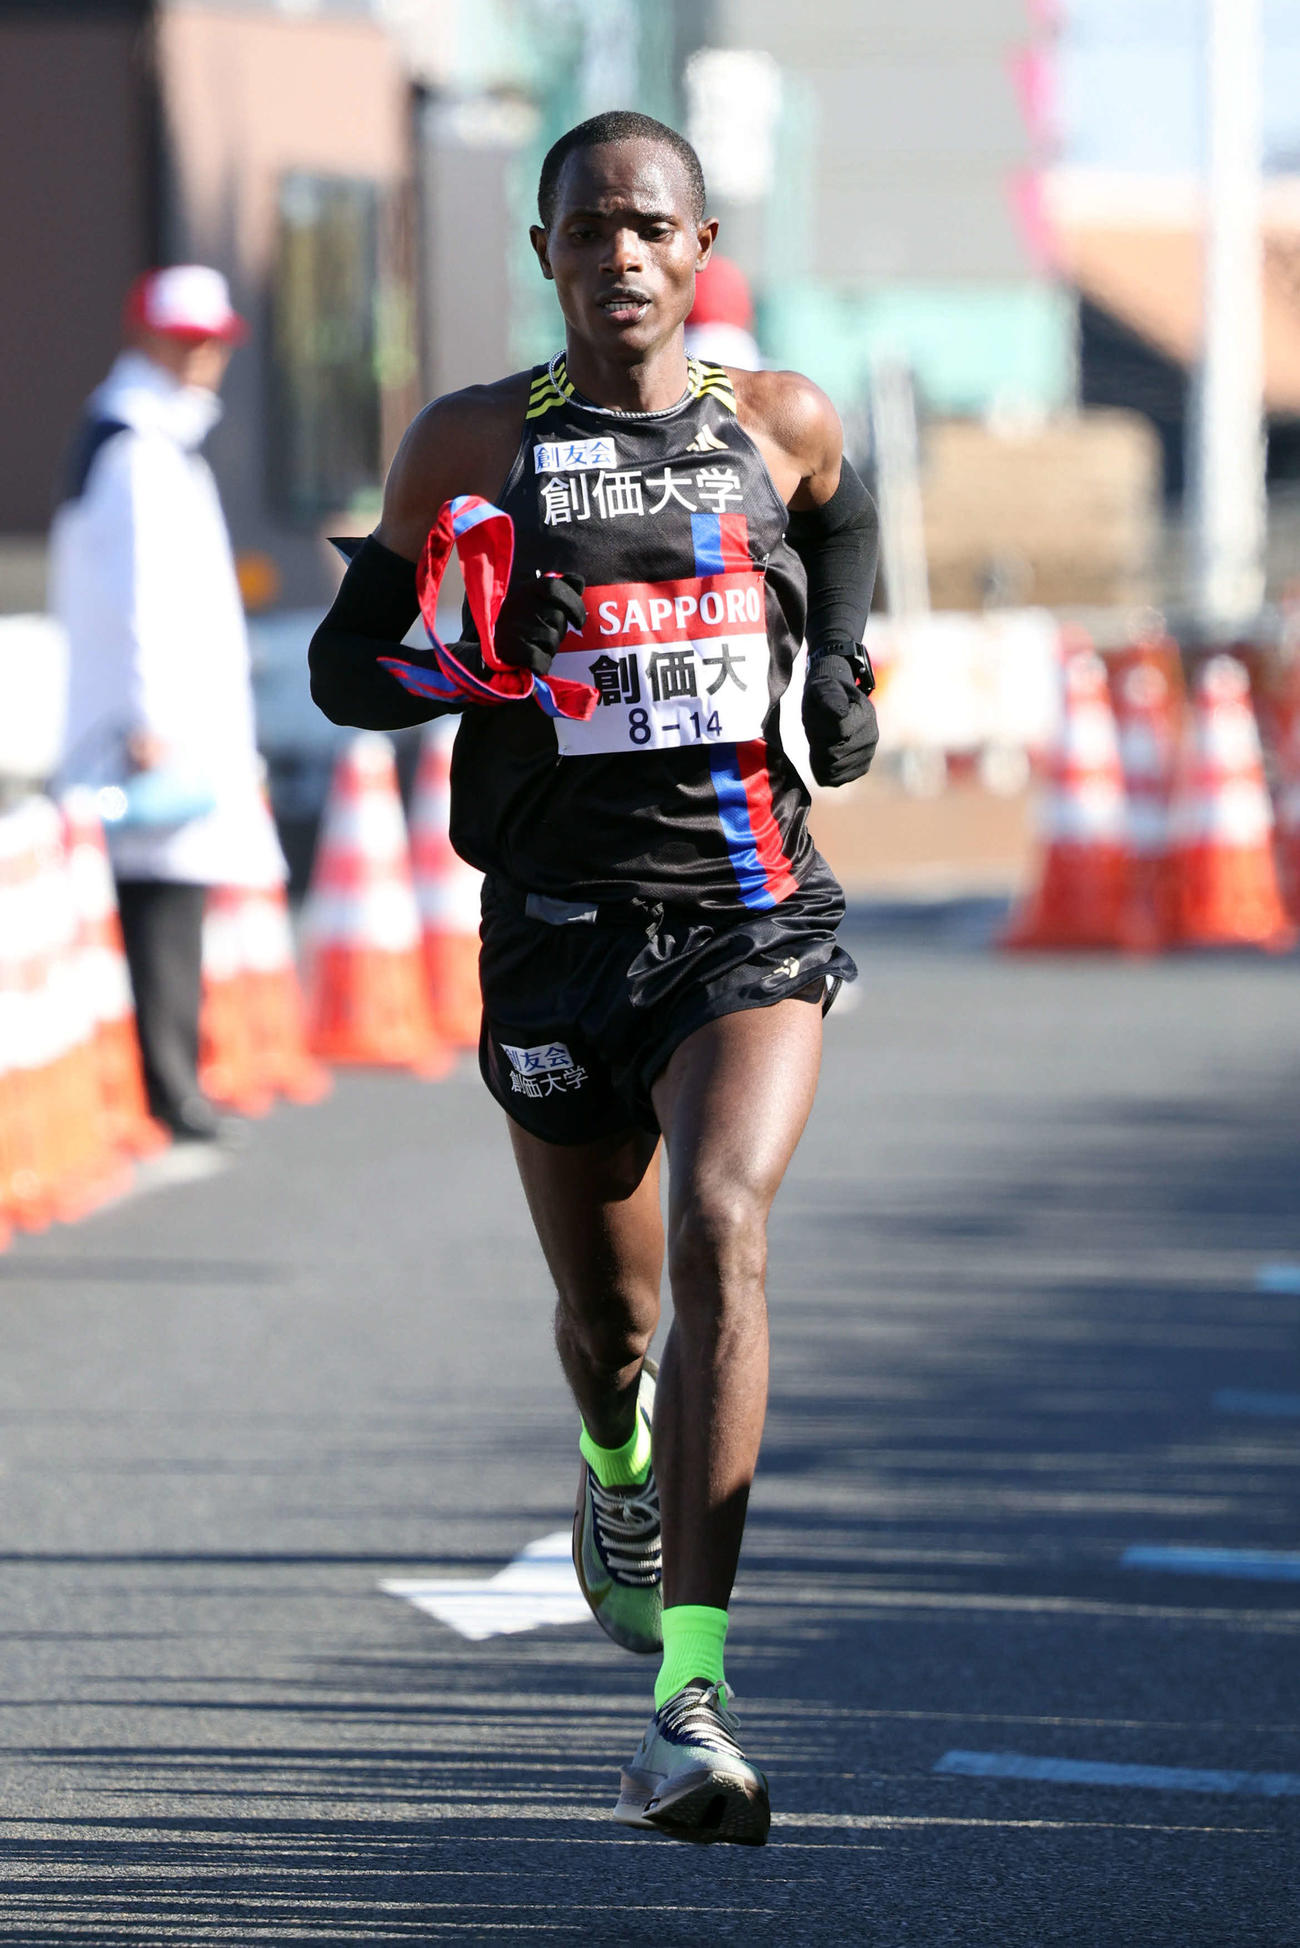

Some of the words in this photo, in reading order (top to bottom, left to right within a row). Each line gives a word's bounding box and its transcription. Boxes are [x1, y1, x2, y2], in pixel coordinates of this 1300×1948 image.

[536, 441, 611, 468] 創友会
[541, 467, 743, 526] 創価大学
[598, 587, 761, 636] SAPPORO
[589, 643, 748, 706] 創価大
[509, 1065, 589, 1098] 創価大学
